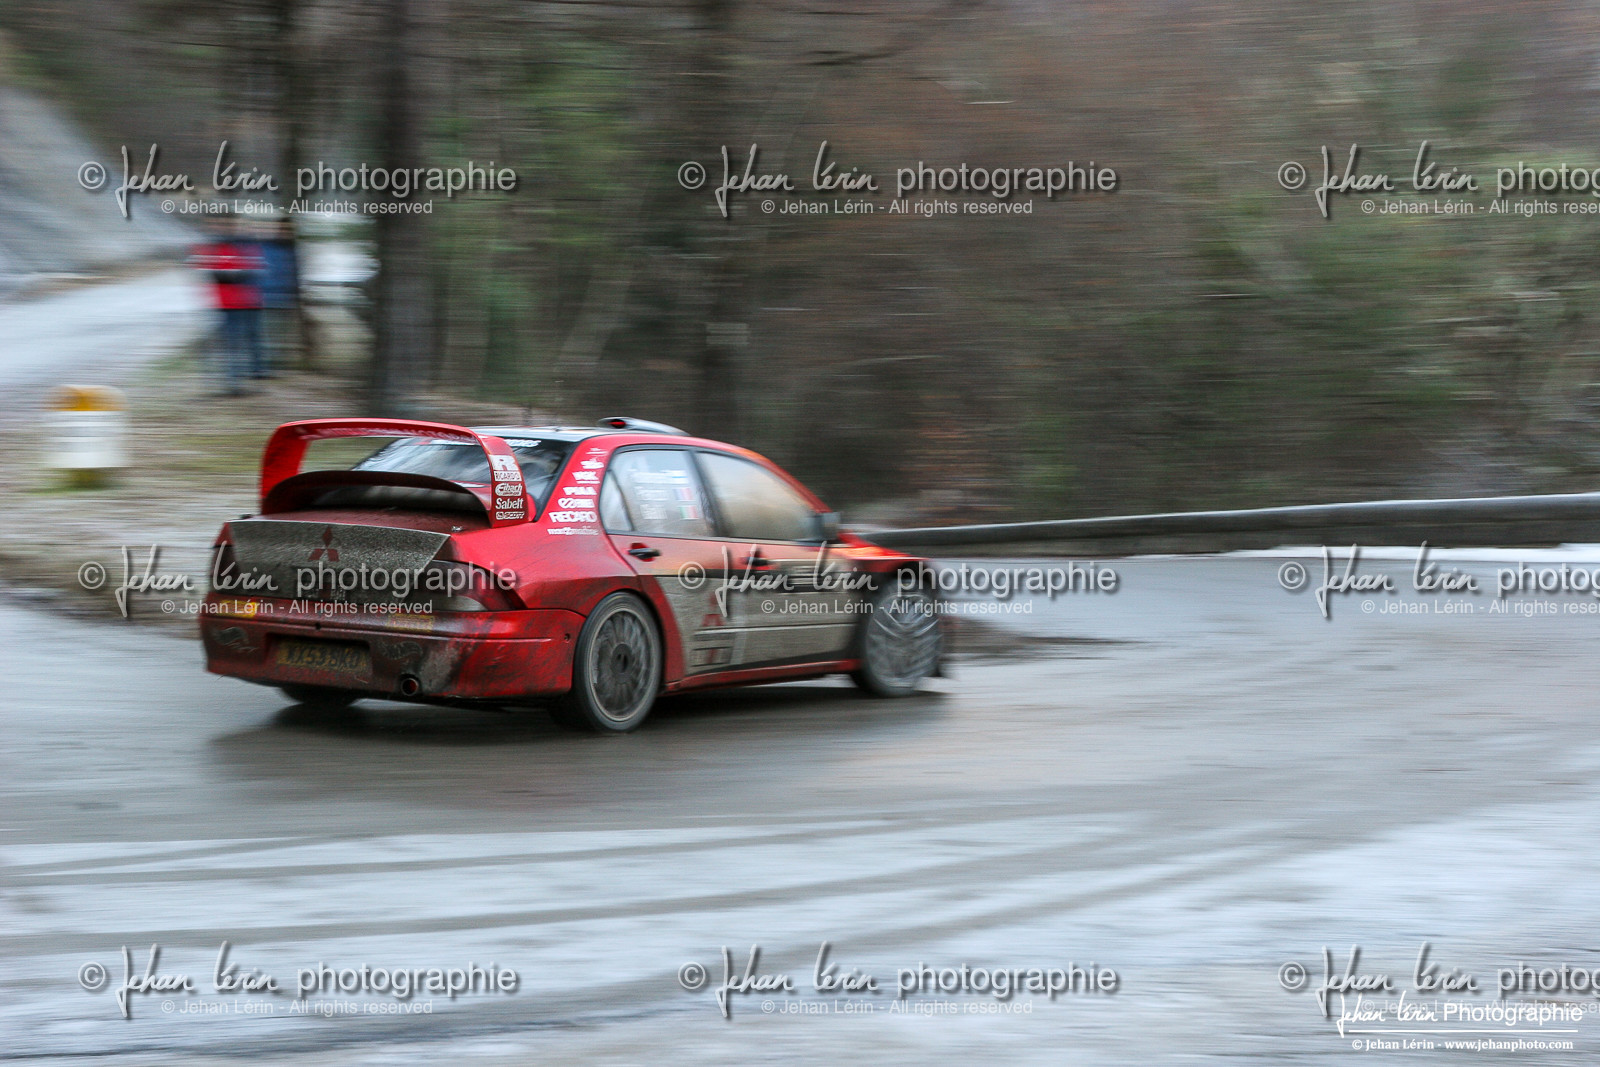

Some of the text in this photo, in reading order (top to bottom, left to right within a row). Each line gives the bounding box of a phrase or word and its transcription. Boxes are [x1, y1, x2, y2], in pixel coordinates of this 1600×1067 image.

[495, 472, 521, 480] RICARDO
[495, 498, 523, 510] Sabelt
[549, 511, 598, 522] RECARO
